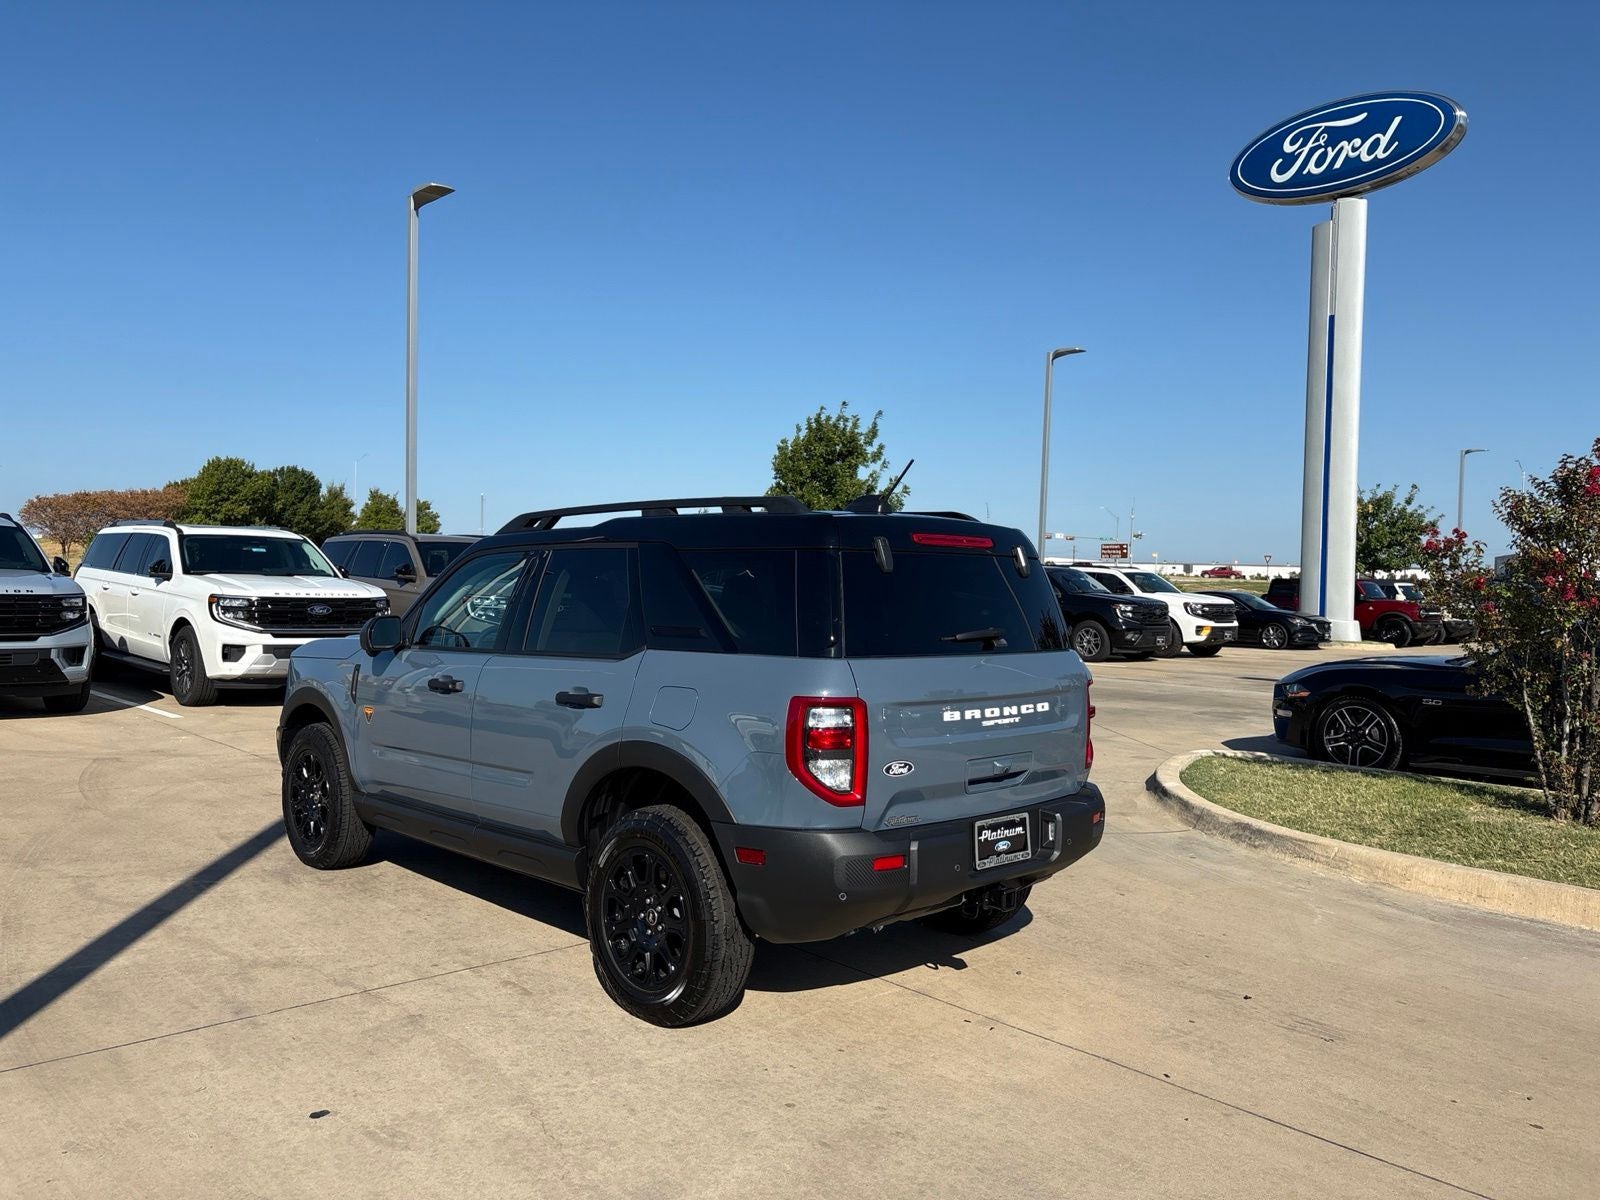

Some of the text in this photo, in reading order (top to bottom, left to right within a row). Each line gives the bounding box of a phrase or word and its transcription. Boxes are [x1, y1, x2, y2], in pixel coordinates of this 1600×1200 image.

[1270, 112, 1403, 183] Ford
[943, 702, 1050, 722] BRONCO
[981, 716, 1021, 727] SPORT
[889, 763, 910, 775] Ford
[978, 826, 1026, 842] Platinum
[986, 853, 1021, 866] Platinum
